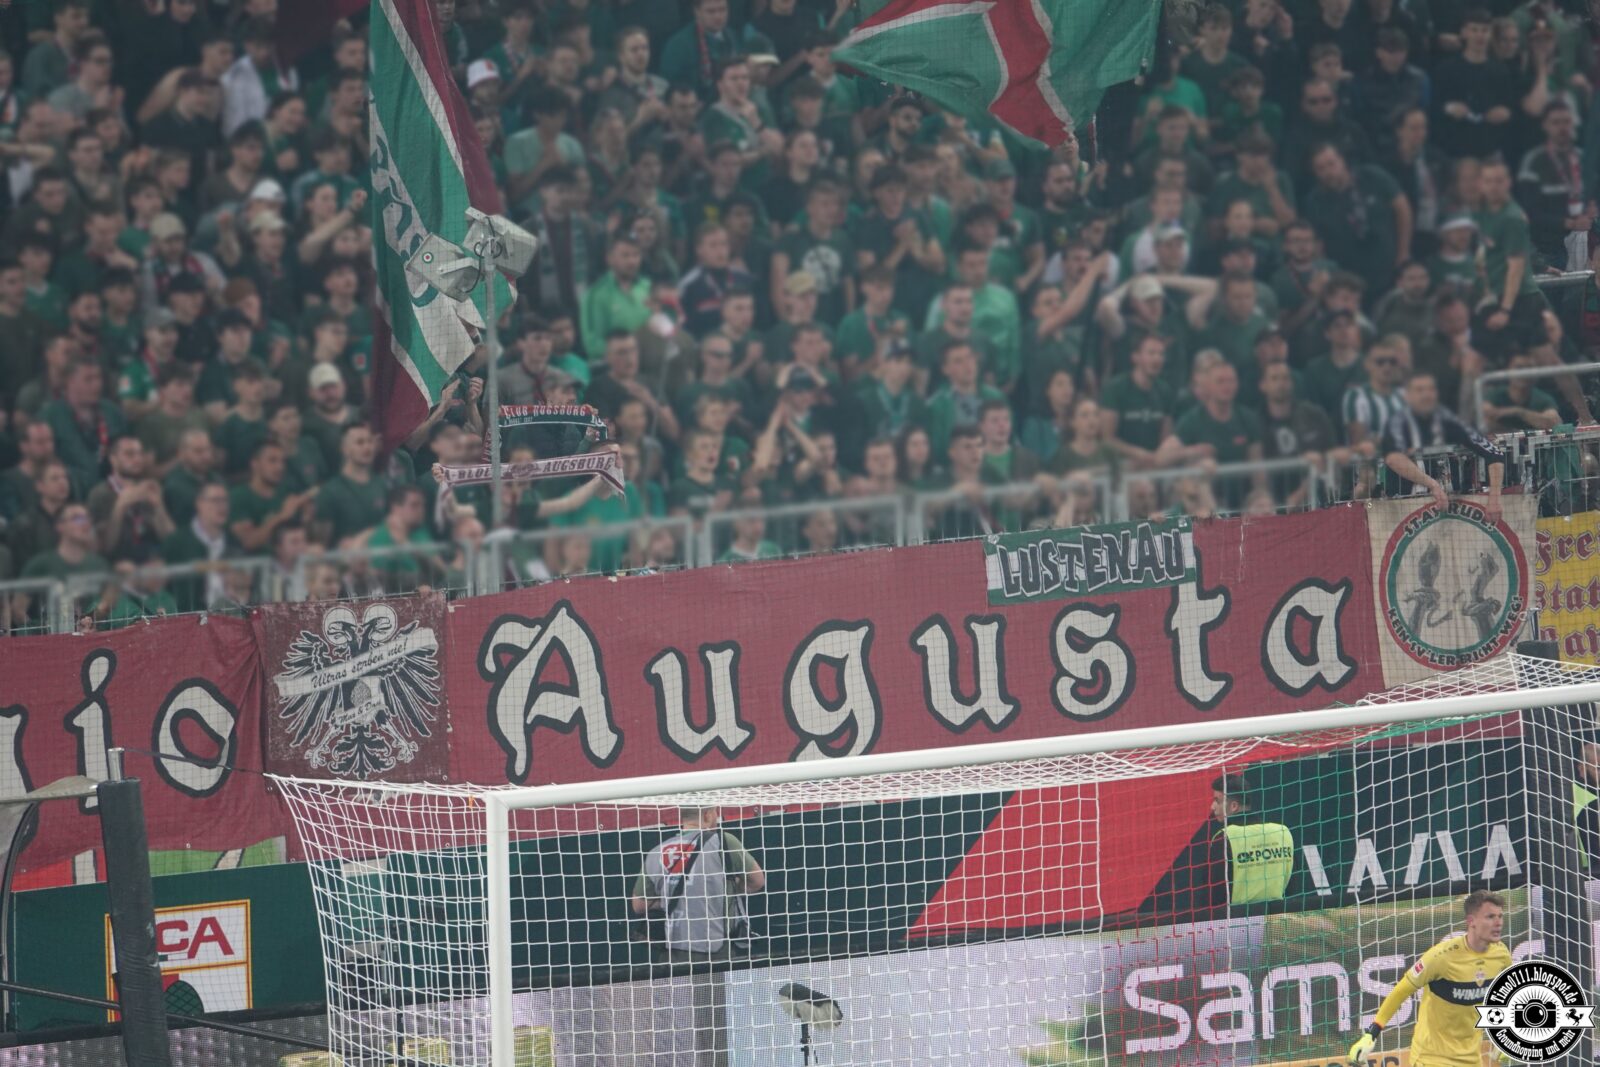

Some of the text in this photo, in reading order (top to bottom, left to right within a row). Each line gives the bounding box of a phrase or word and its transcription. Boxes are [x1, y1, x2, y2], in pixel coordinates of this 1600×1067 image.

[543, 456, 614, 473] AUGSBURG
[997, 522, 1185, 598] LUSTENAU
[1536, 525, 1600, 575] Fre
[1387, 606, 1411, 643] KEIN
[1499, 595, 1523, 636] WEG!
[311, 668, 347, 689] Ultras
[154, 916, 235, 960] CA
